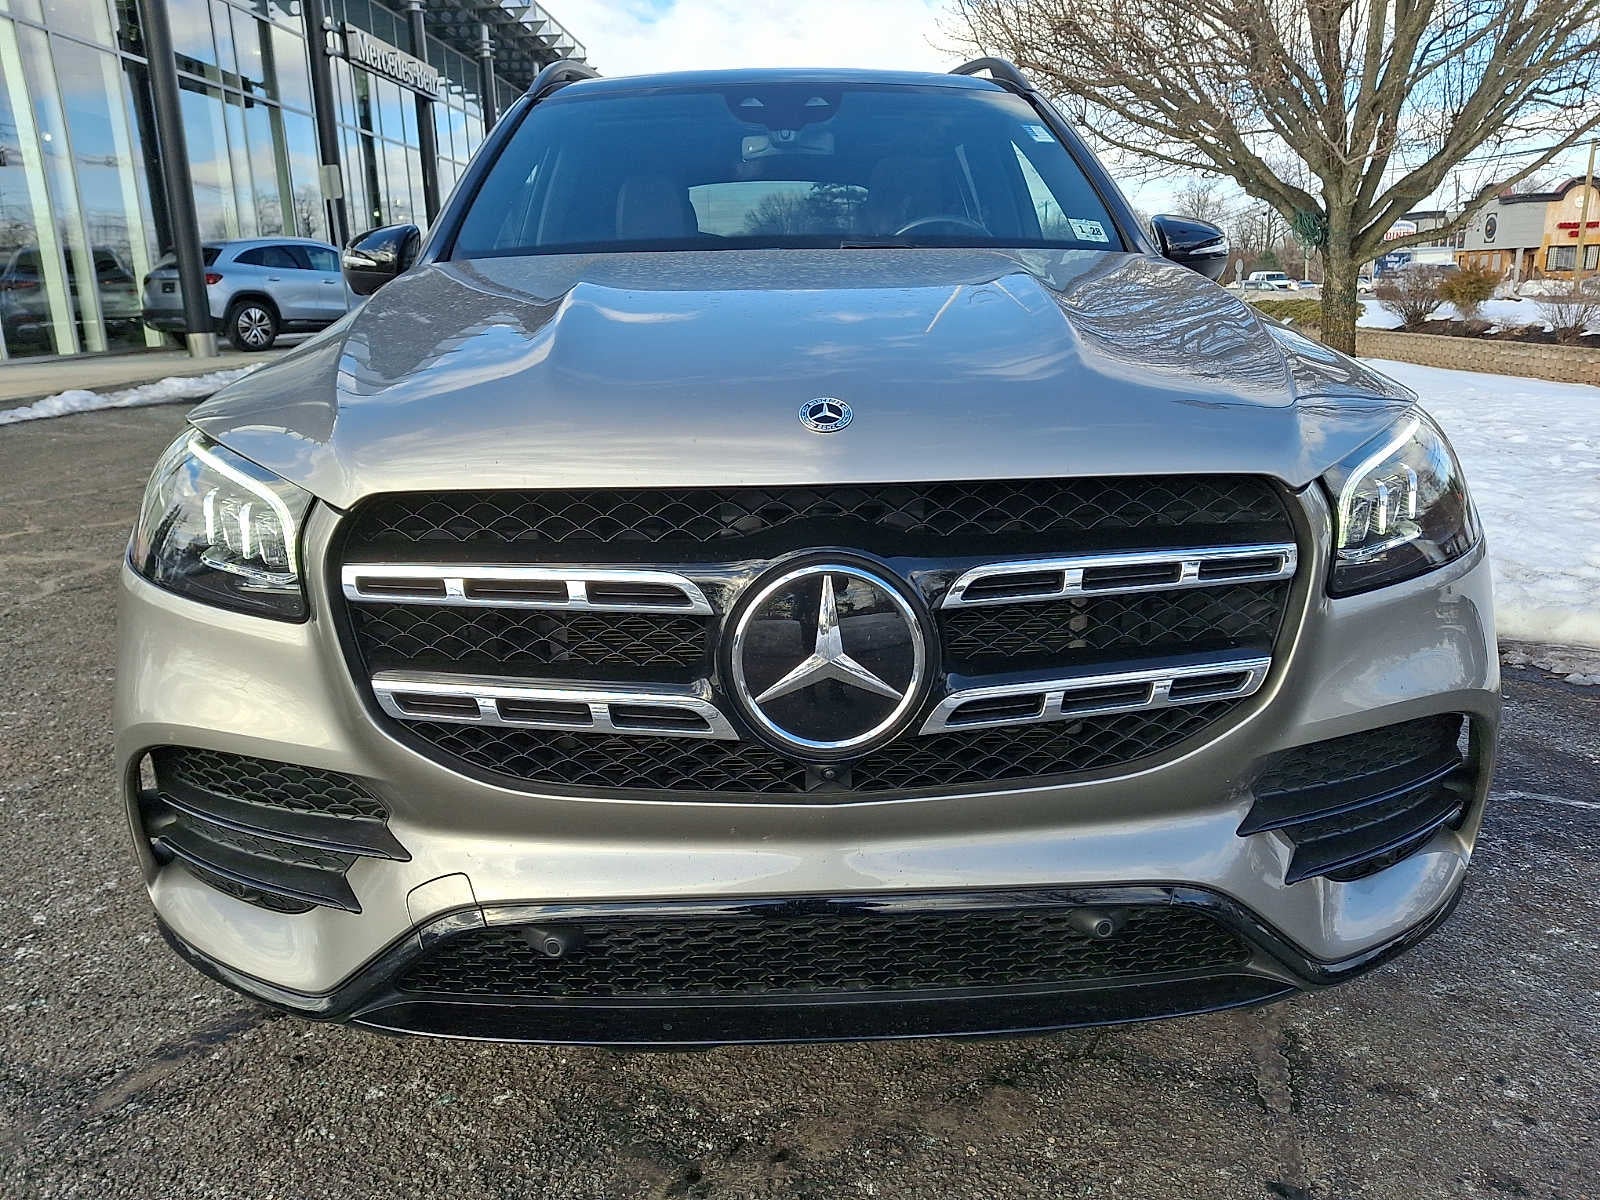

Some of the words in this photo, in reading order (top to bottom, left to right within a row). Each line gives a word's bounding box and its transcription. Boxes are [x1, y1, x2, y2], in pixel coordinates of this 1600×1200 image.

[358, 31, 440, 96] Mercedes-Benz
[1078, 225, 1086, 233] 1
[1089, 226, 1102, 236] 28
